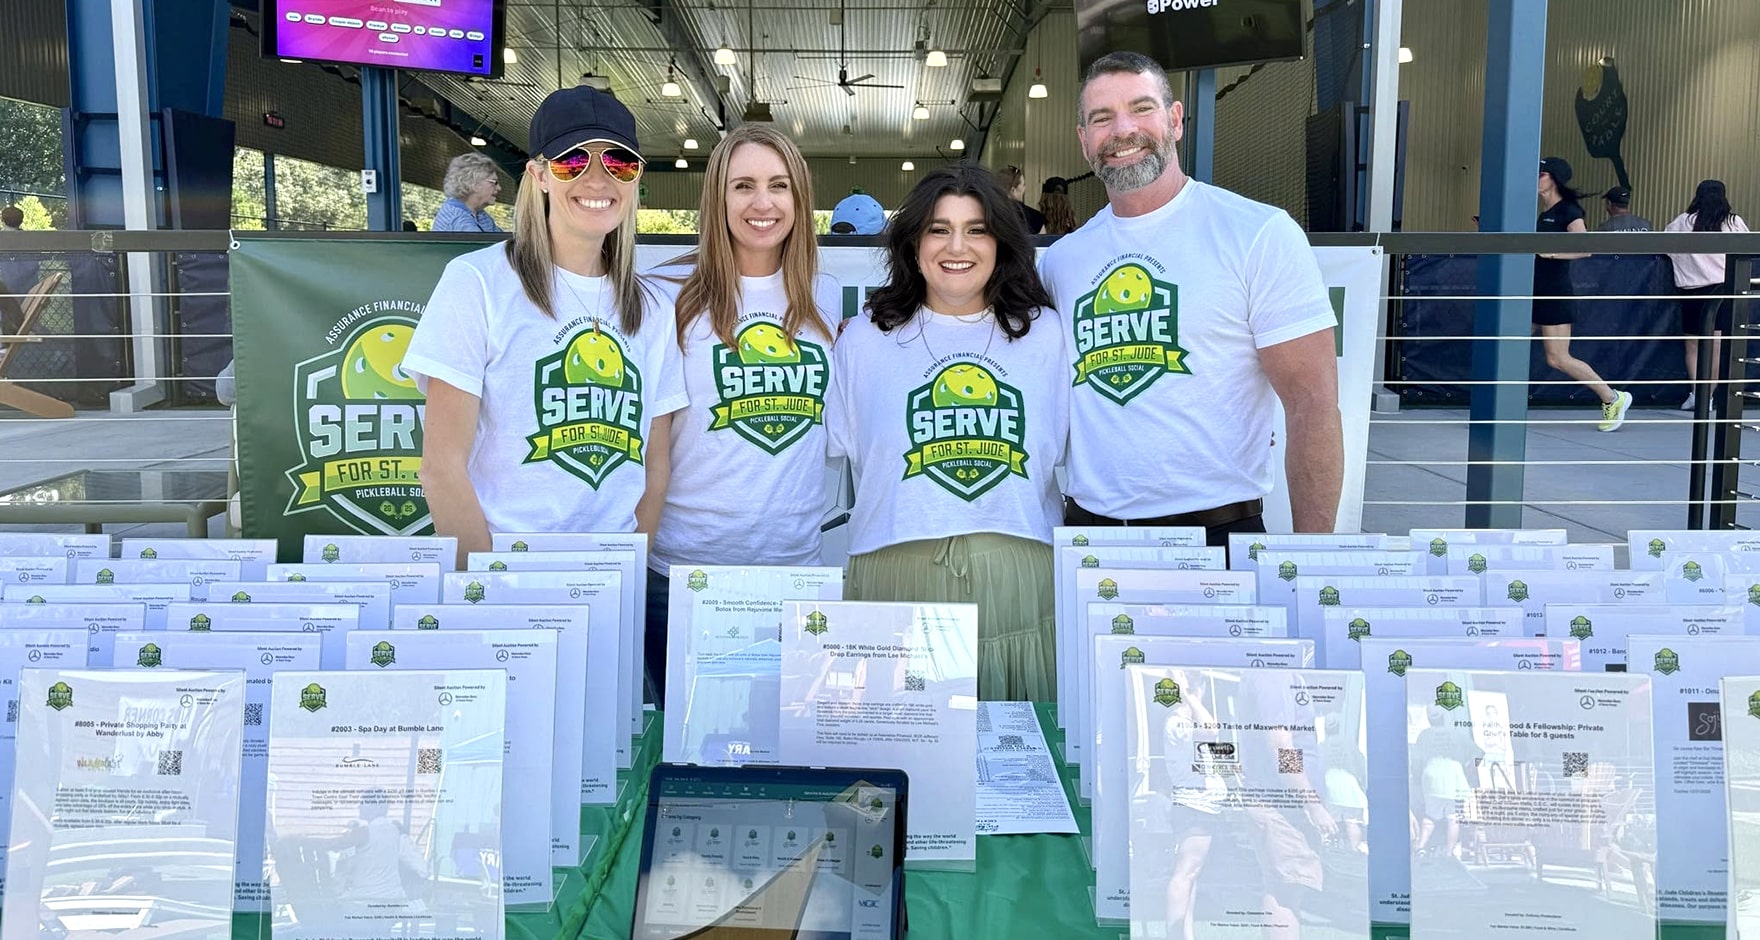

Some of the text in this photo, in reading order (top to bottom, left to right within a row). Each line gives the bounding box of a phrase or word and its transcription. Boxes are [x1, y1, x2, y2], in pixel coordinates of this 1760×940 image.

[394, 8, 408, 16] play
[1586, 88, 1619, 133] COURT
[1091, 252, 1166, 285] ASSURANCE FINANCIAL PRESENTS
[325, 300, 426, 345] ASSURANCE FINANCIAL
[749, 311, 778, 322] FINANCIAL
[553, 317, 584, 346] ASSURANCE
[1077, 308, 1172, 354] SERVE
[1090, 346, 1158, 366] FOR ST. JUDE
[923, 352, 1008, 378] ASSURANCE FINANCIAL PRESENTS
[1098, 364, 1145, 376] PICKLEBALL SOCIAL
[721, 364, 824, 399] SERVE
[542, 386, 638, 430] SERVE
[740, 398, 810, 414] FOR ST. JUDE
[750, 414, 798, 424] PICKLEBALL SOCIAL
[912, 408, 1020, 444] SERVE
[308, 404, 426, 459] SER
[561, 426, 586, 444] FOR
[931, 442, 1005, 458] FOR ST. JUDE
[336, 459, 406, 483] FOR ST.
[942, 459, 992, 469] PICKLEBALL SOCIAL
[356, 486, 407, 499] PICKLEBALL
[383, 504, 414, 512] 20 25
[74, 720, 95, 728] #8005
[100, 720, 124, 728] Private
[126, 721, 158, 730] Shopping
[160, 722, 178, 730] Party
[358, 726, 372, 734] Spa
[374, 725, 388, 734] Day
[1222, 722, 1242, 730] Taste
[1290, 724, 1315, 732] Market
[1533, 723, 1576, 732] Fellowship:
[1578, 724, 1604, 732] Private
[136, 730, 144, 738] by
[146, 730, 164, 738] Abby
